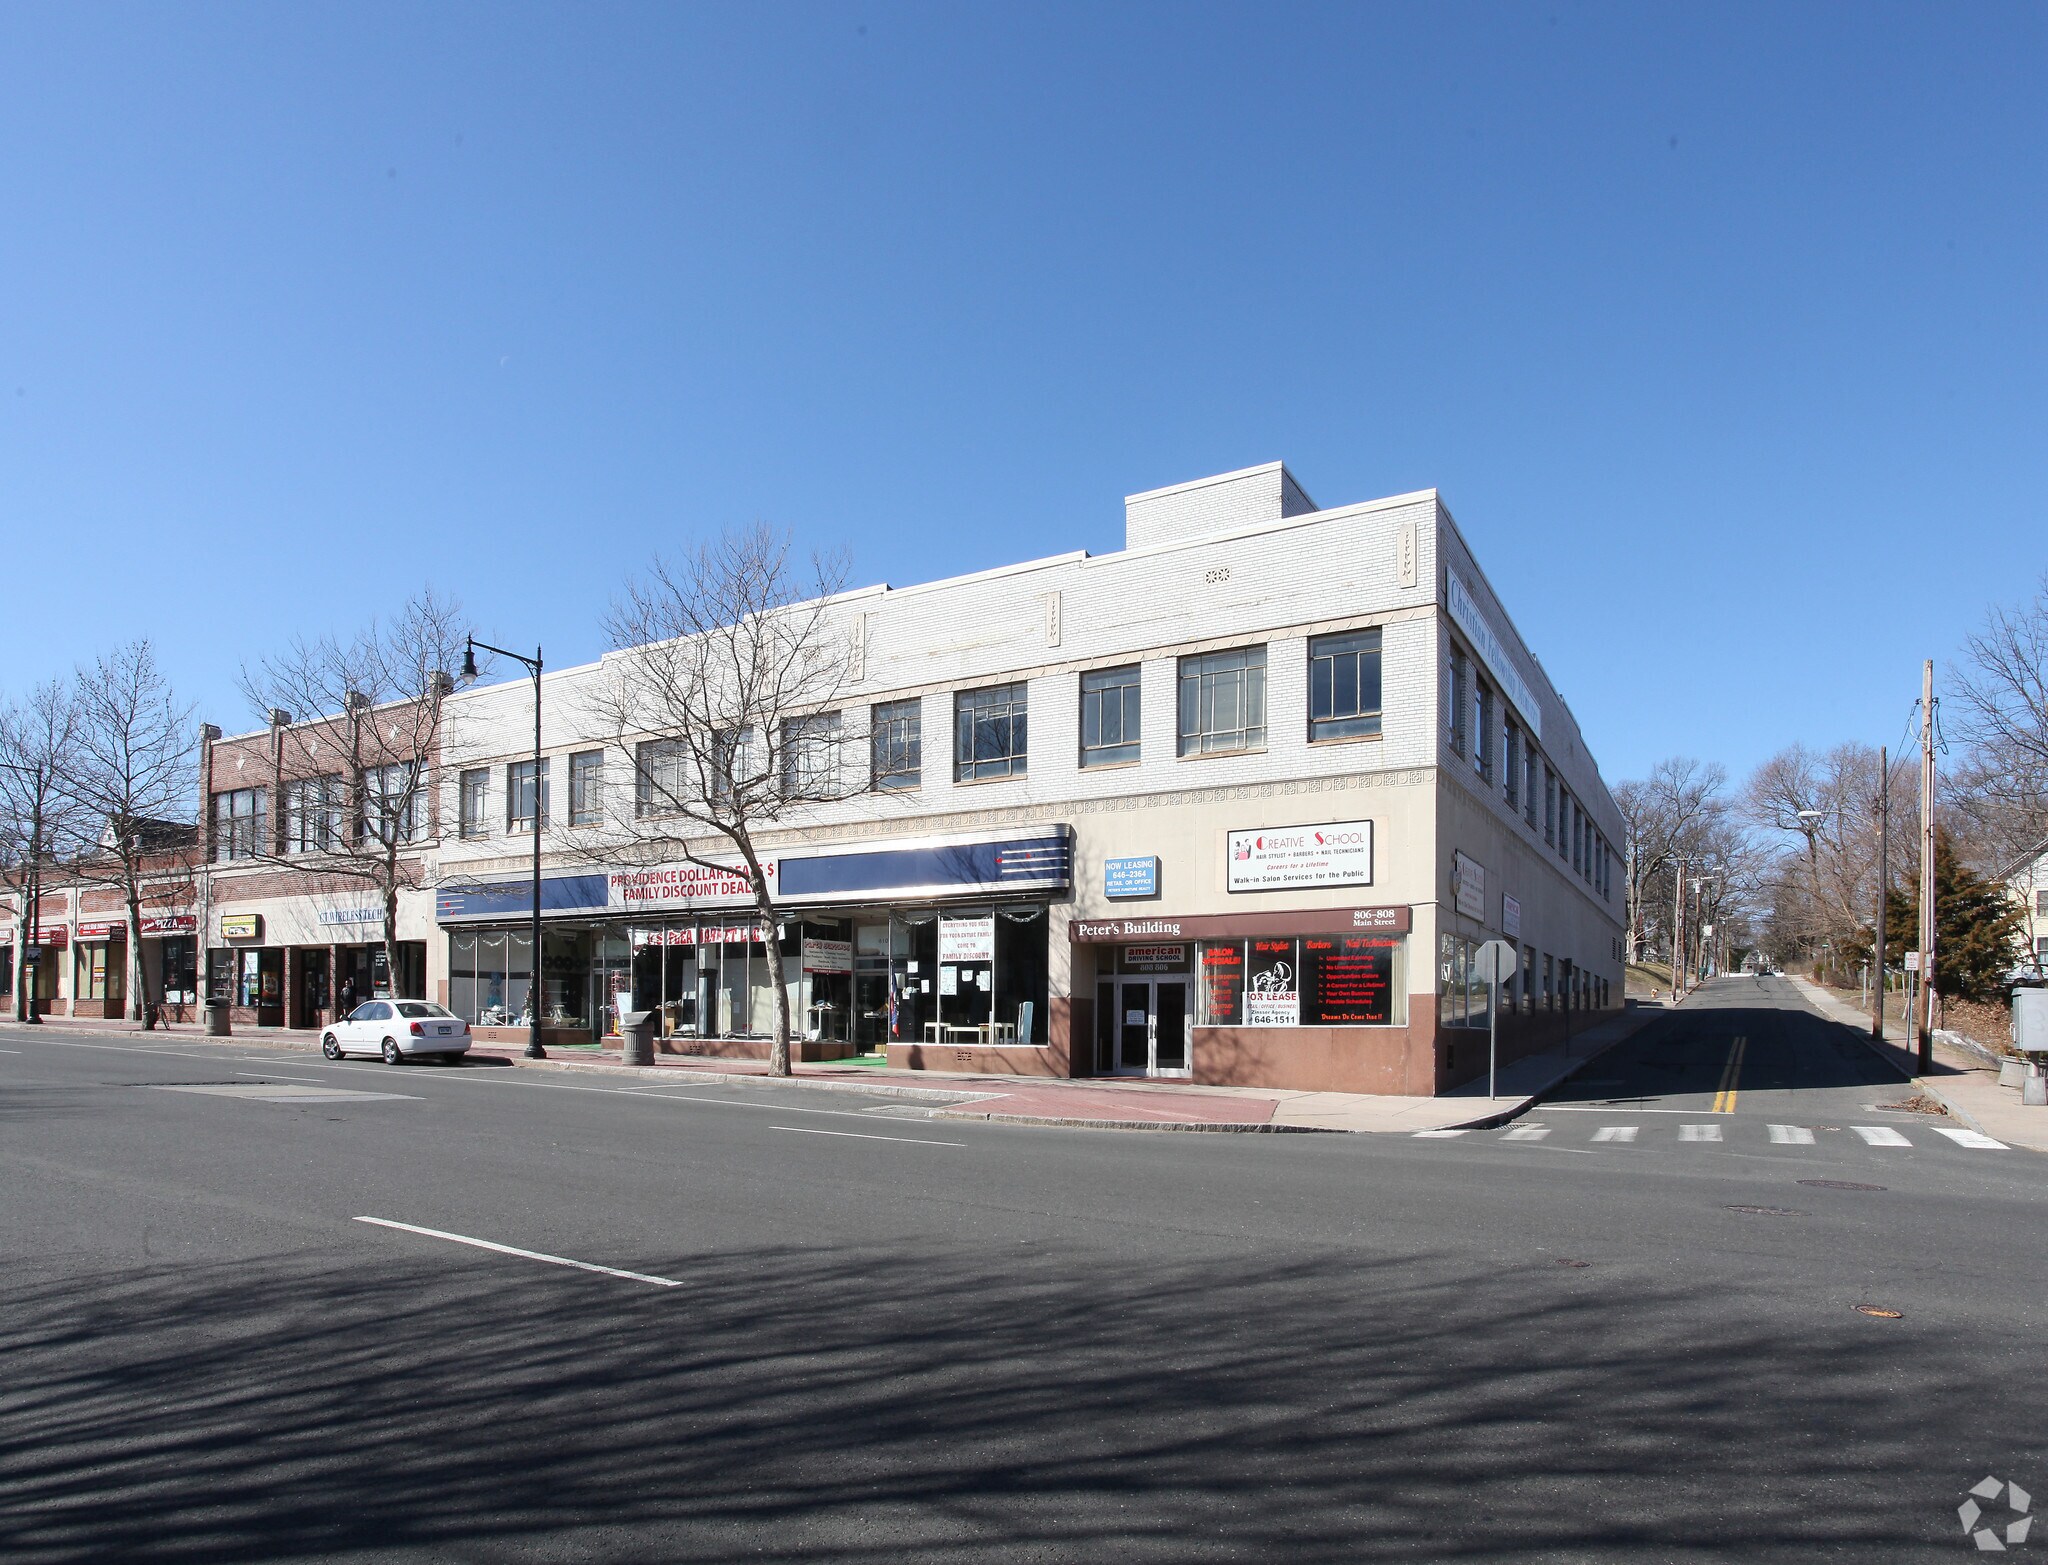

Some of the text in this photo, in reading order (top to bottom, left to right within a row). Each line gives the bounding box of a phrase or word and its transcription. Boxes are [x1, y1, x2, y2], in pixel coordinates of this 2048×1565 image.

[1452, 579, 1486, 650] Christian
[1256, 832, 1364, 850] CREATIVE SCHOOL
[1334, 847, 1364, 855] TECHNICIANS
[1106, 860, 1152, 870] NOW LEASING
[1267, 863, 1288, 871] Careers
[612, 862, 774, 887] PROVIDENCE DOLLAR DEA $
[1234, 876, 1260, 884] Walk-in
[1262, 875, 1280, 883] Salon
[624, 880, 756, 900] FAMILY DISCOUNT DEAL
[1354, 910, 1394, 919] 806-808
[156, 918, 178, 928] PIZZA
[1078, 922, 1180, 936] Peter's Building
[1128, 946, 1181, 955] american
[1208, 948, 1234, 956] SALON
[1247, 992, 1297, 1000] OR LEASE
